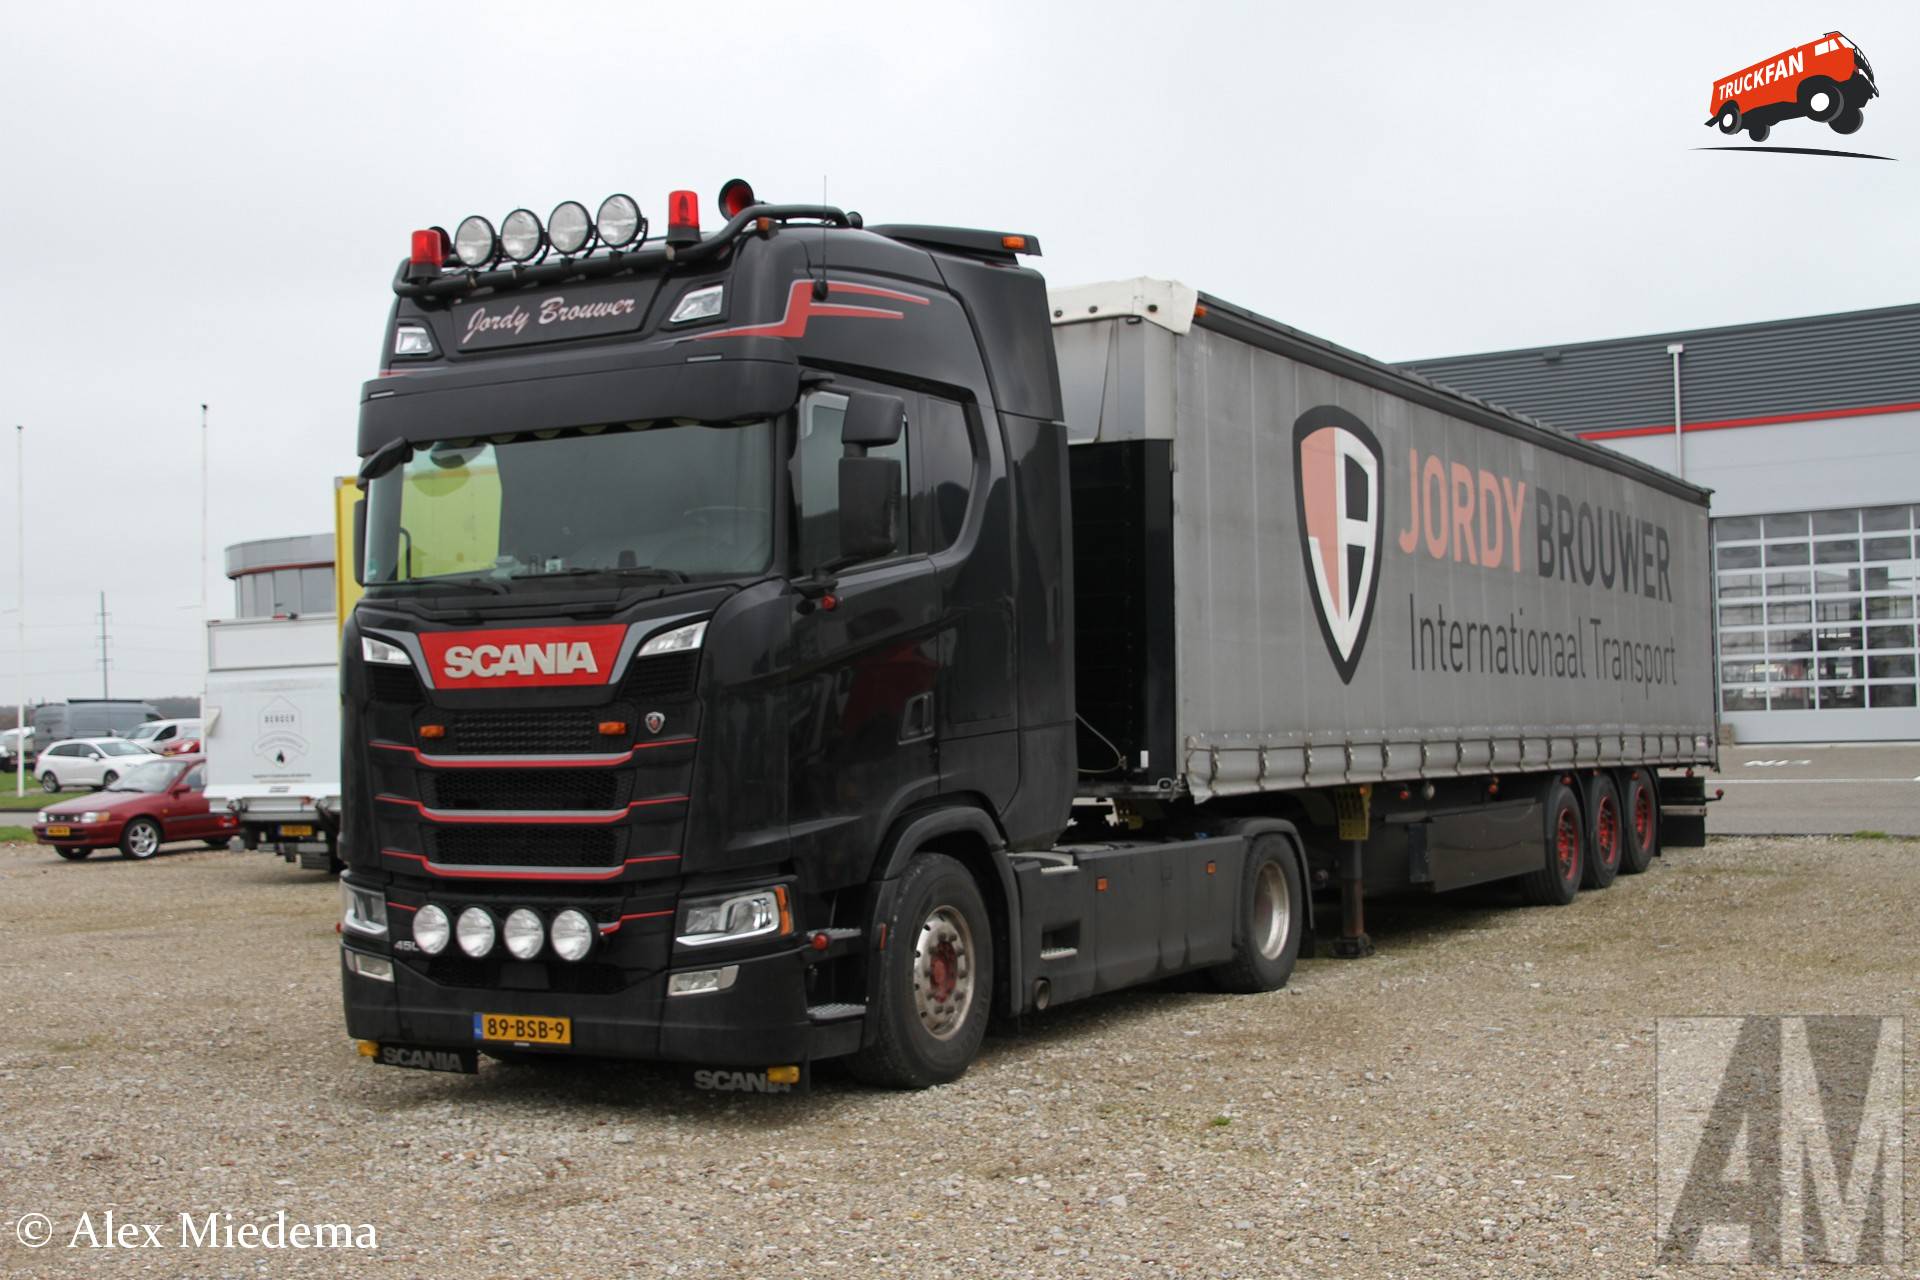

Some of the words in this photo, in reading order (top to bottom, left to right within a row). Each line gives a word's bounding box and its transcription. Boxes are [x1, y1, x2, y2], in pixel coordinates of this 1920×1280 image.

[462, 305, 530, 344] Jordy
[538, 296, 635, 325] Brouwer
[1399, 448, 1526, 573] JORDY
[1535, 487, 1673, 603] BROUWER
[444, 641, 598, 679] SCANIA
[1409, 593, 1587, 679] Internationaal
[1590, 617, 1677, 700] Transport
[488, 1018, 564, 1040] 89-BSB-9
[383, 1046, 463, 1072] SCANIA
[694, 1069, 791, 1093] SCAN
